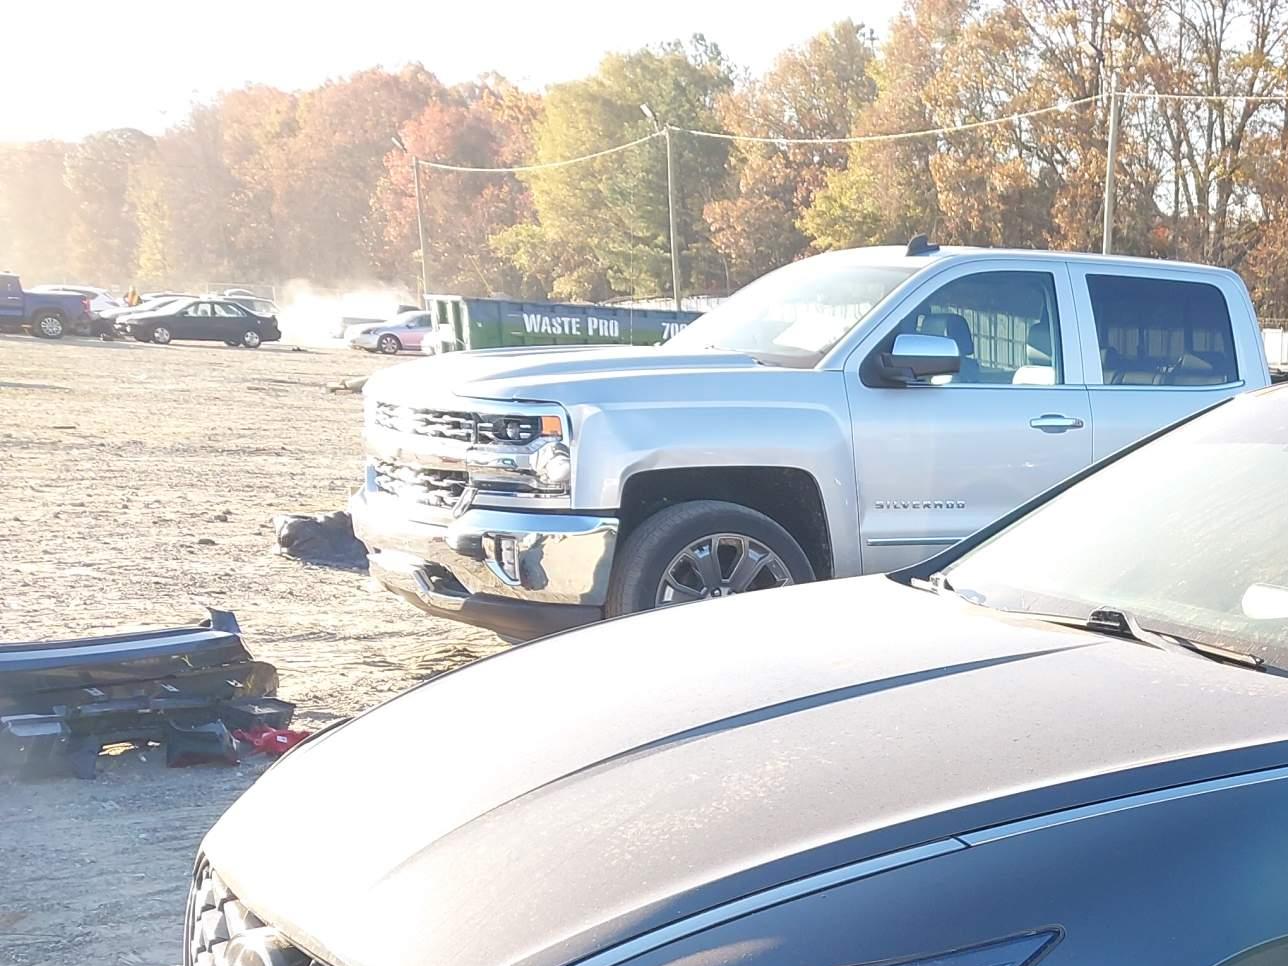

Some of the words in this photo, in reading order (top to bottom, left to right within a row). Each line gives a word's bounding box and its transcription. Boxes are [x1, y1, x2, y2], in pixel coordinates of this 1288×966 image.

[523, 313, 581, 335] WASTE
[588, 316, 619, 337] PRO
[874, 500, 966, 510] SILVERADO
